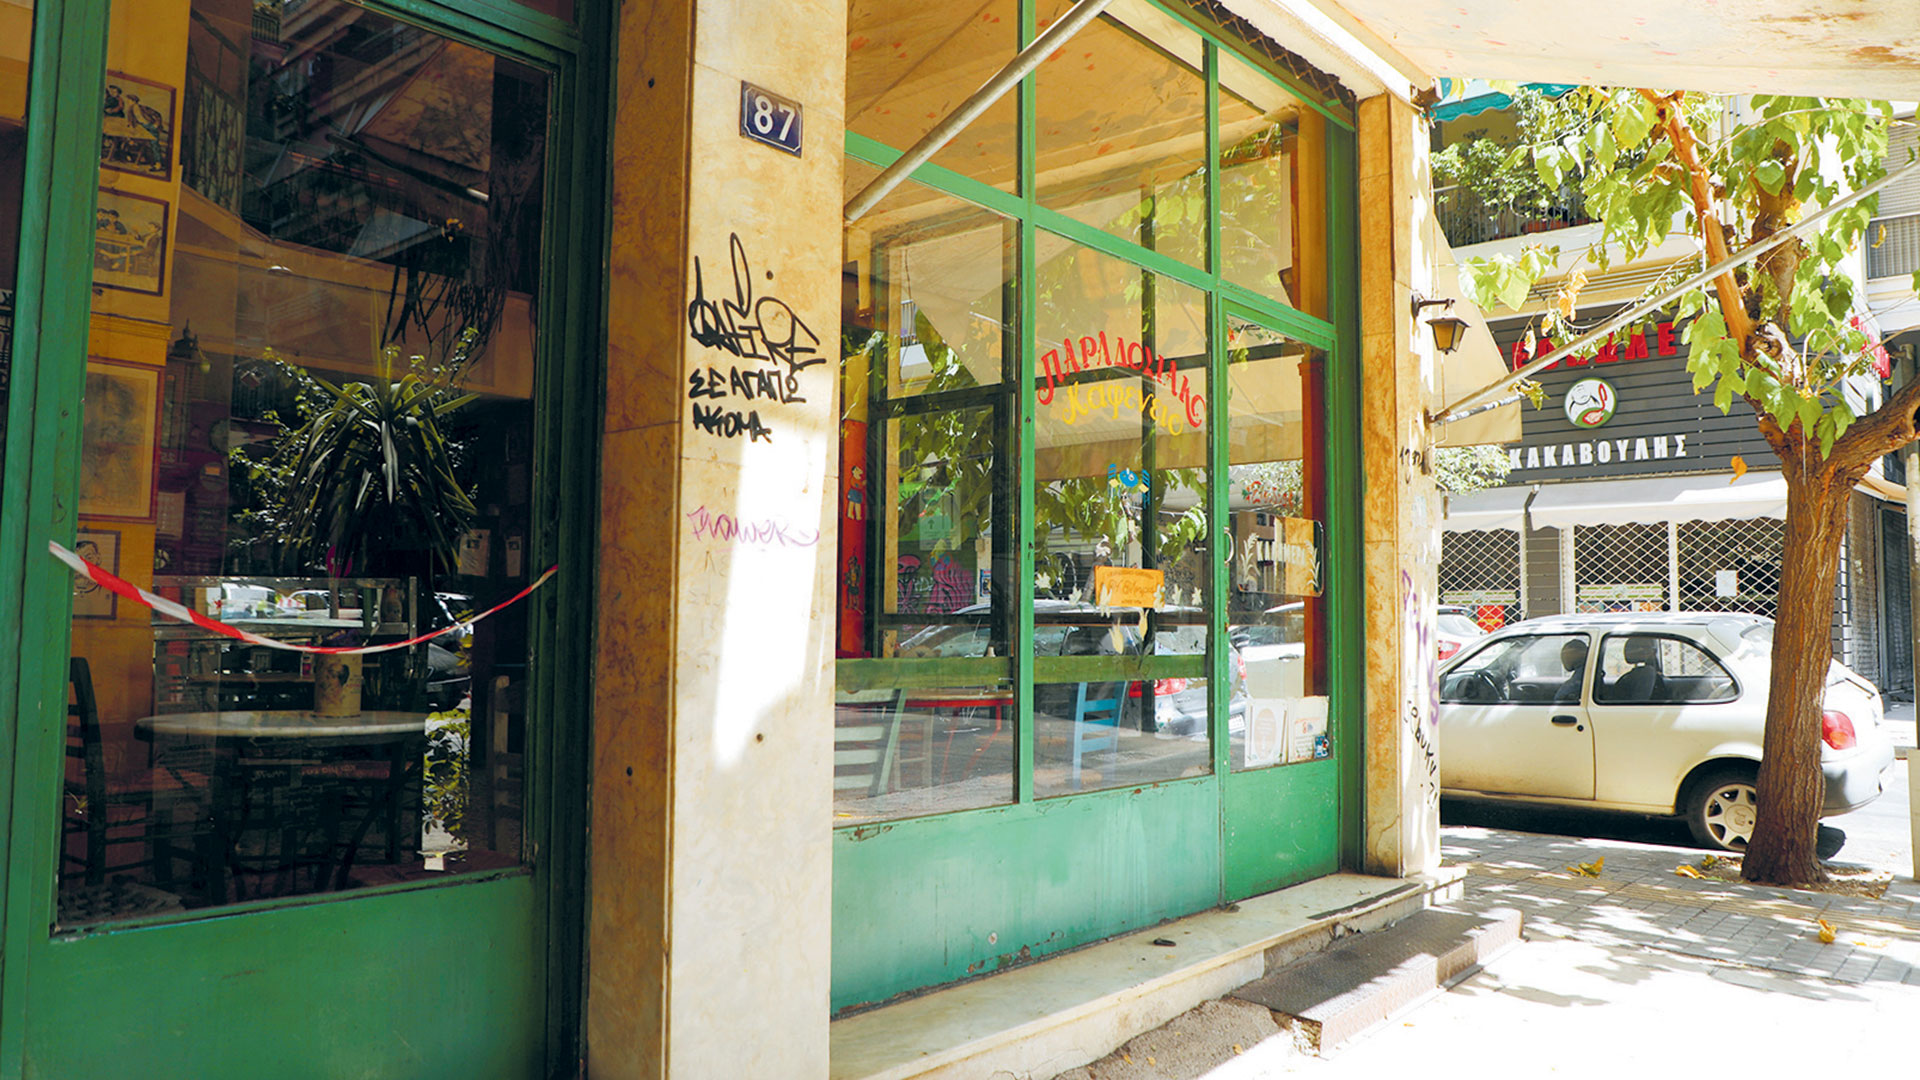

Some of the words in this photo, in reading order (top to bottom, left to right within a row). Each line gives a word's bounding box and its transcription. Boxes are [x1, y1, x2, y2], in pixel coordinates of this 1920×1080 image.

[753, 95, 796, 141] 87
[688, 366, 727, 399] ΣΕ
[730, 365, 807, 405] ΑΓΑΠΩ
[1037, 330, 1206, 428] ΠΑΡΑΔΟΣΙΑΚΟ
[692, 402, 772, 444] ΑΚΟΜΑ
[1509, 434, 1687, 470] ΚΑΚΑΒΟΥΛΗΣ
